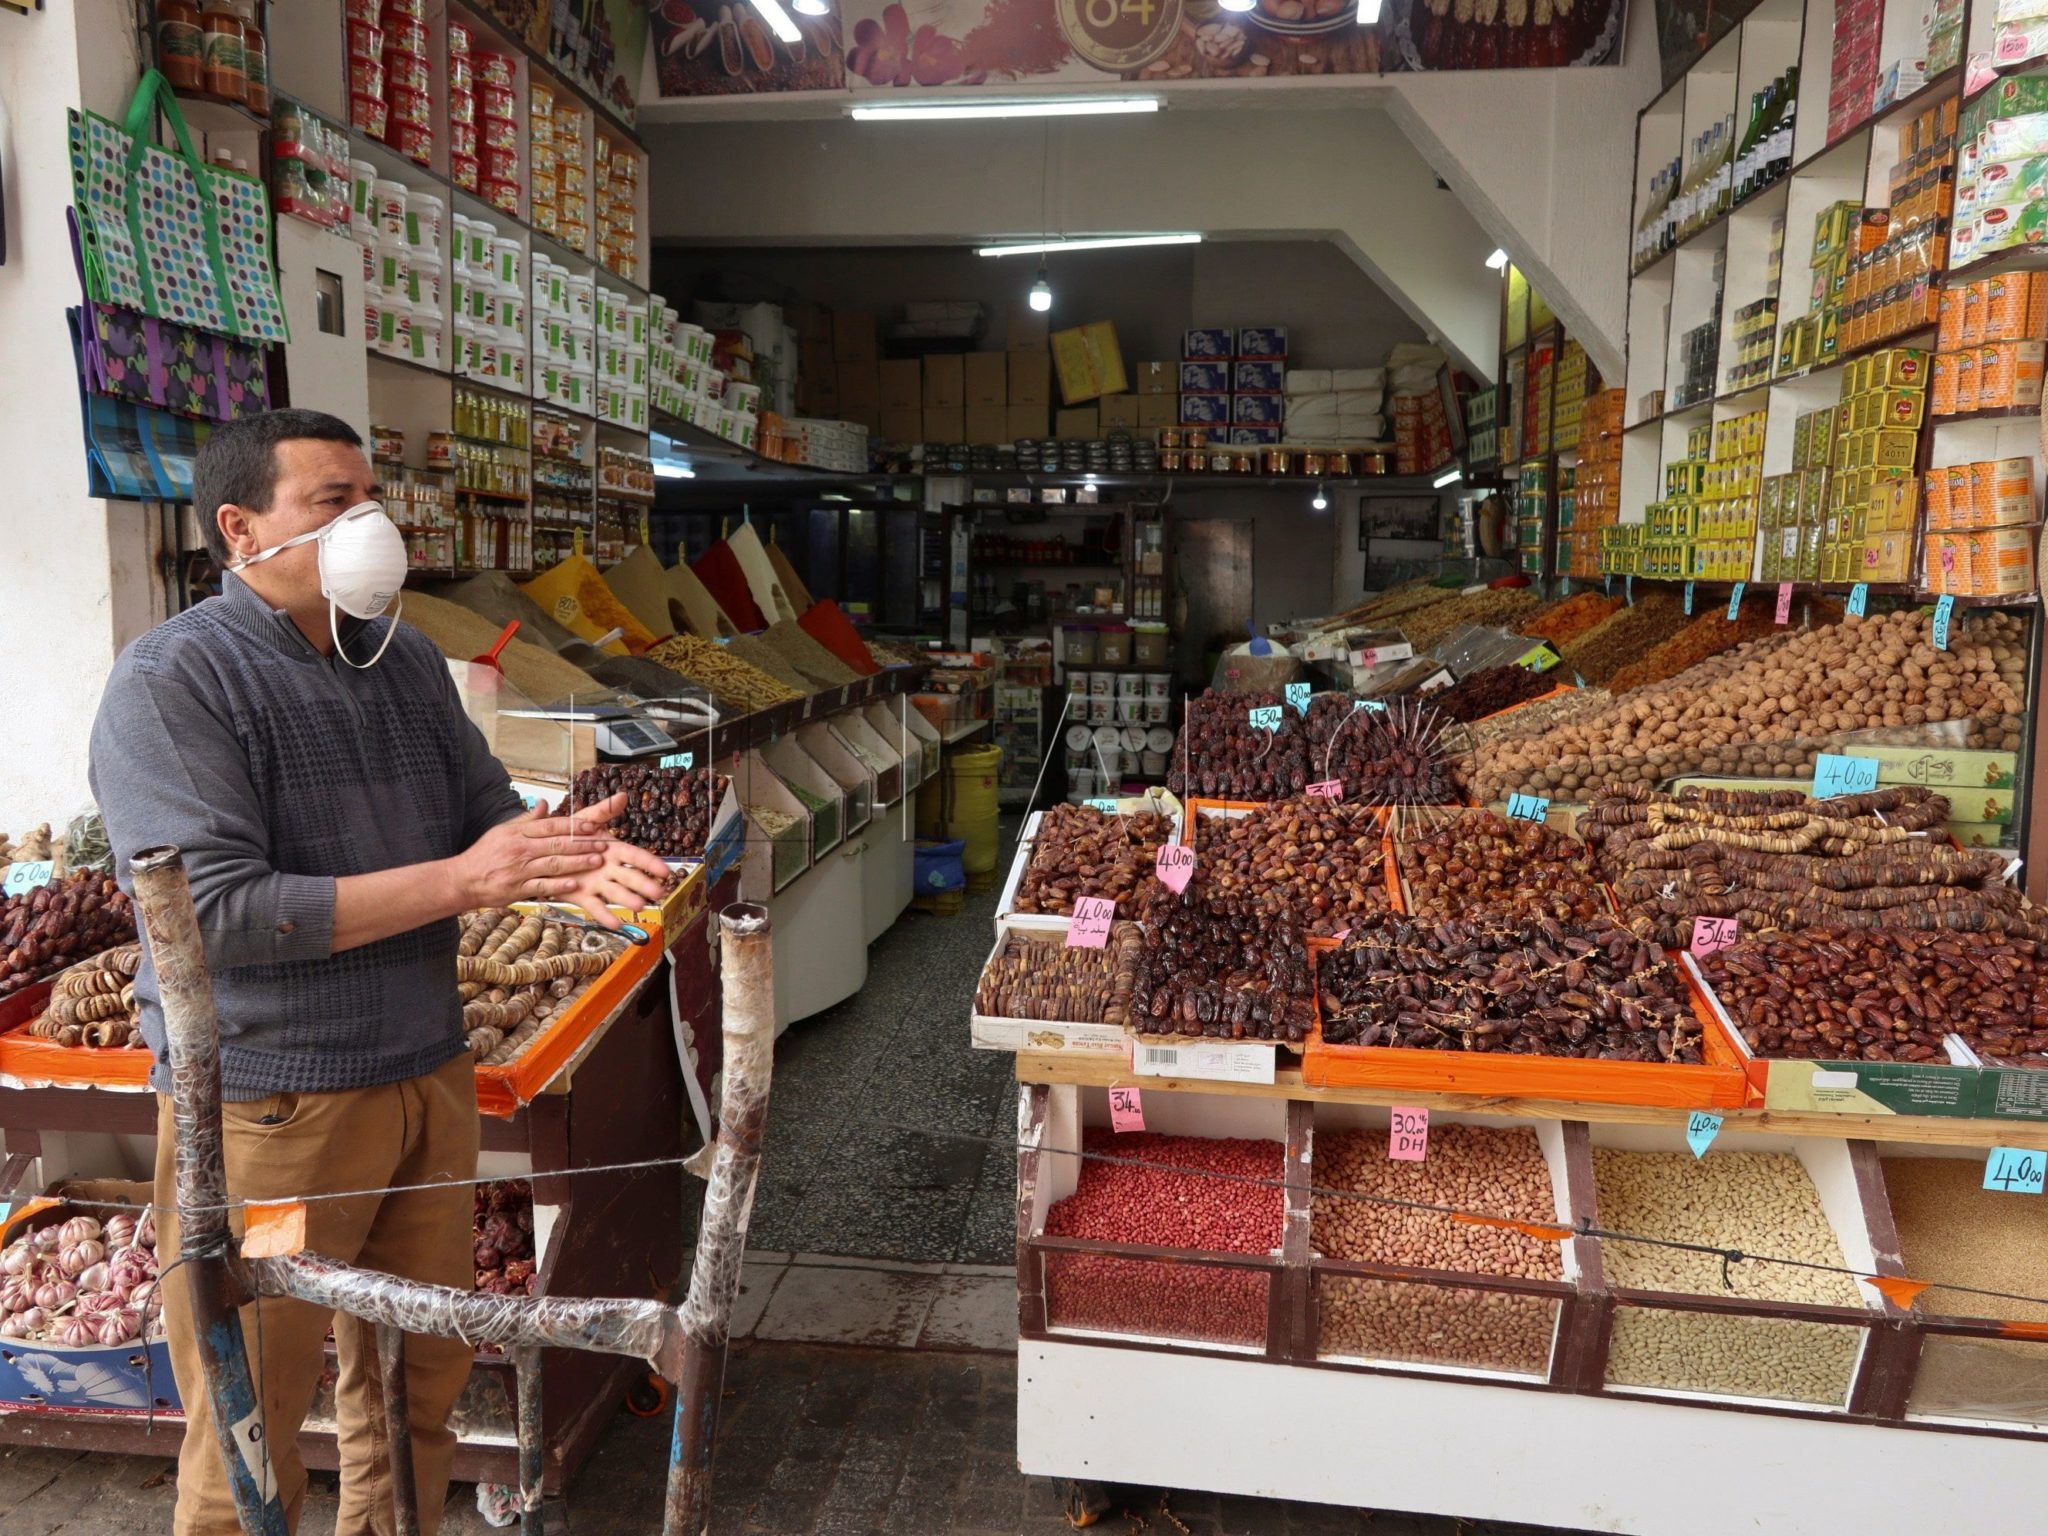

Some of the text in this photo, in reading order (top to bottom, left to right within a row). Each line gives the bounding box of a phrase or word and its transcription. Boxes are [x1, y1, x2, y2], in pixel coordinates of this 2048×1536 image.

[1885, 449, 1906, 459] 4011
[1871, 499, 1885, 512] 4011
[1158, 846, 1193, 871] 40.00
[1698, 918, 1735, 949] 34.00
[1689, 1114, 1719, 1137] 40.00
[1399, 1136, 1424, 1151] DH
[1992, 1152, 2042, 1191] 40.00
